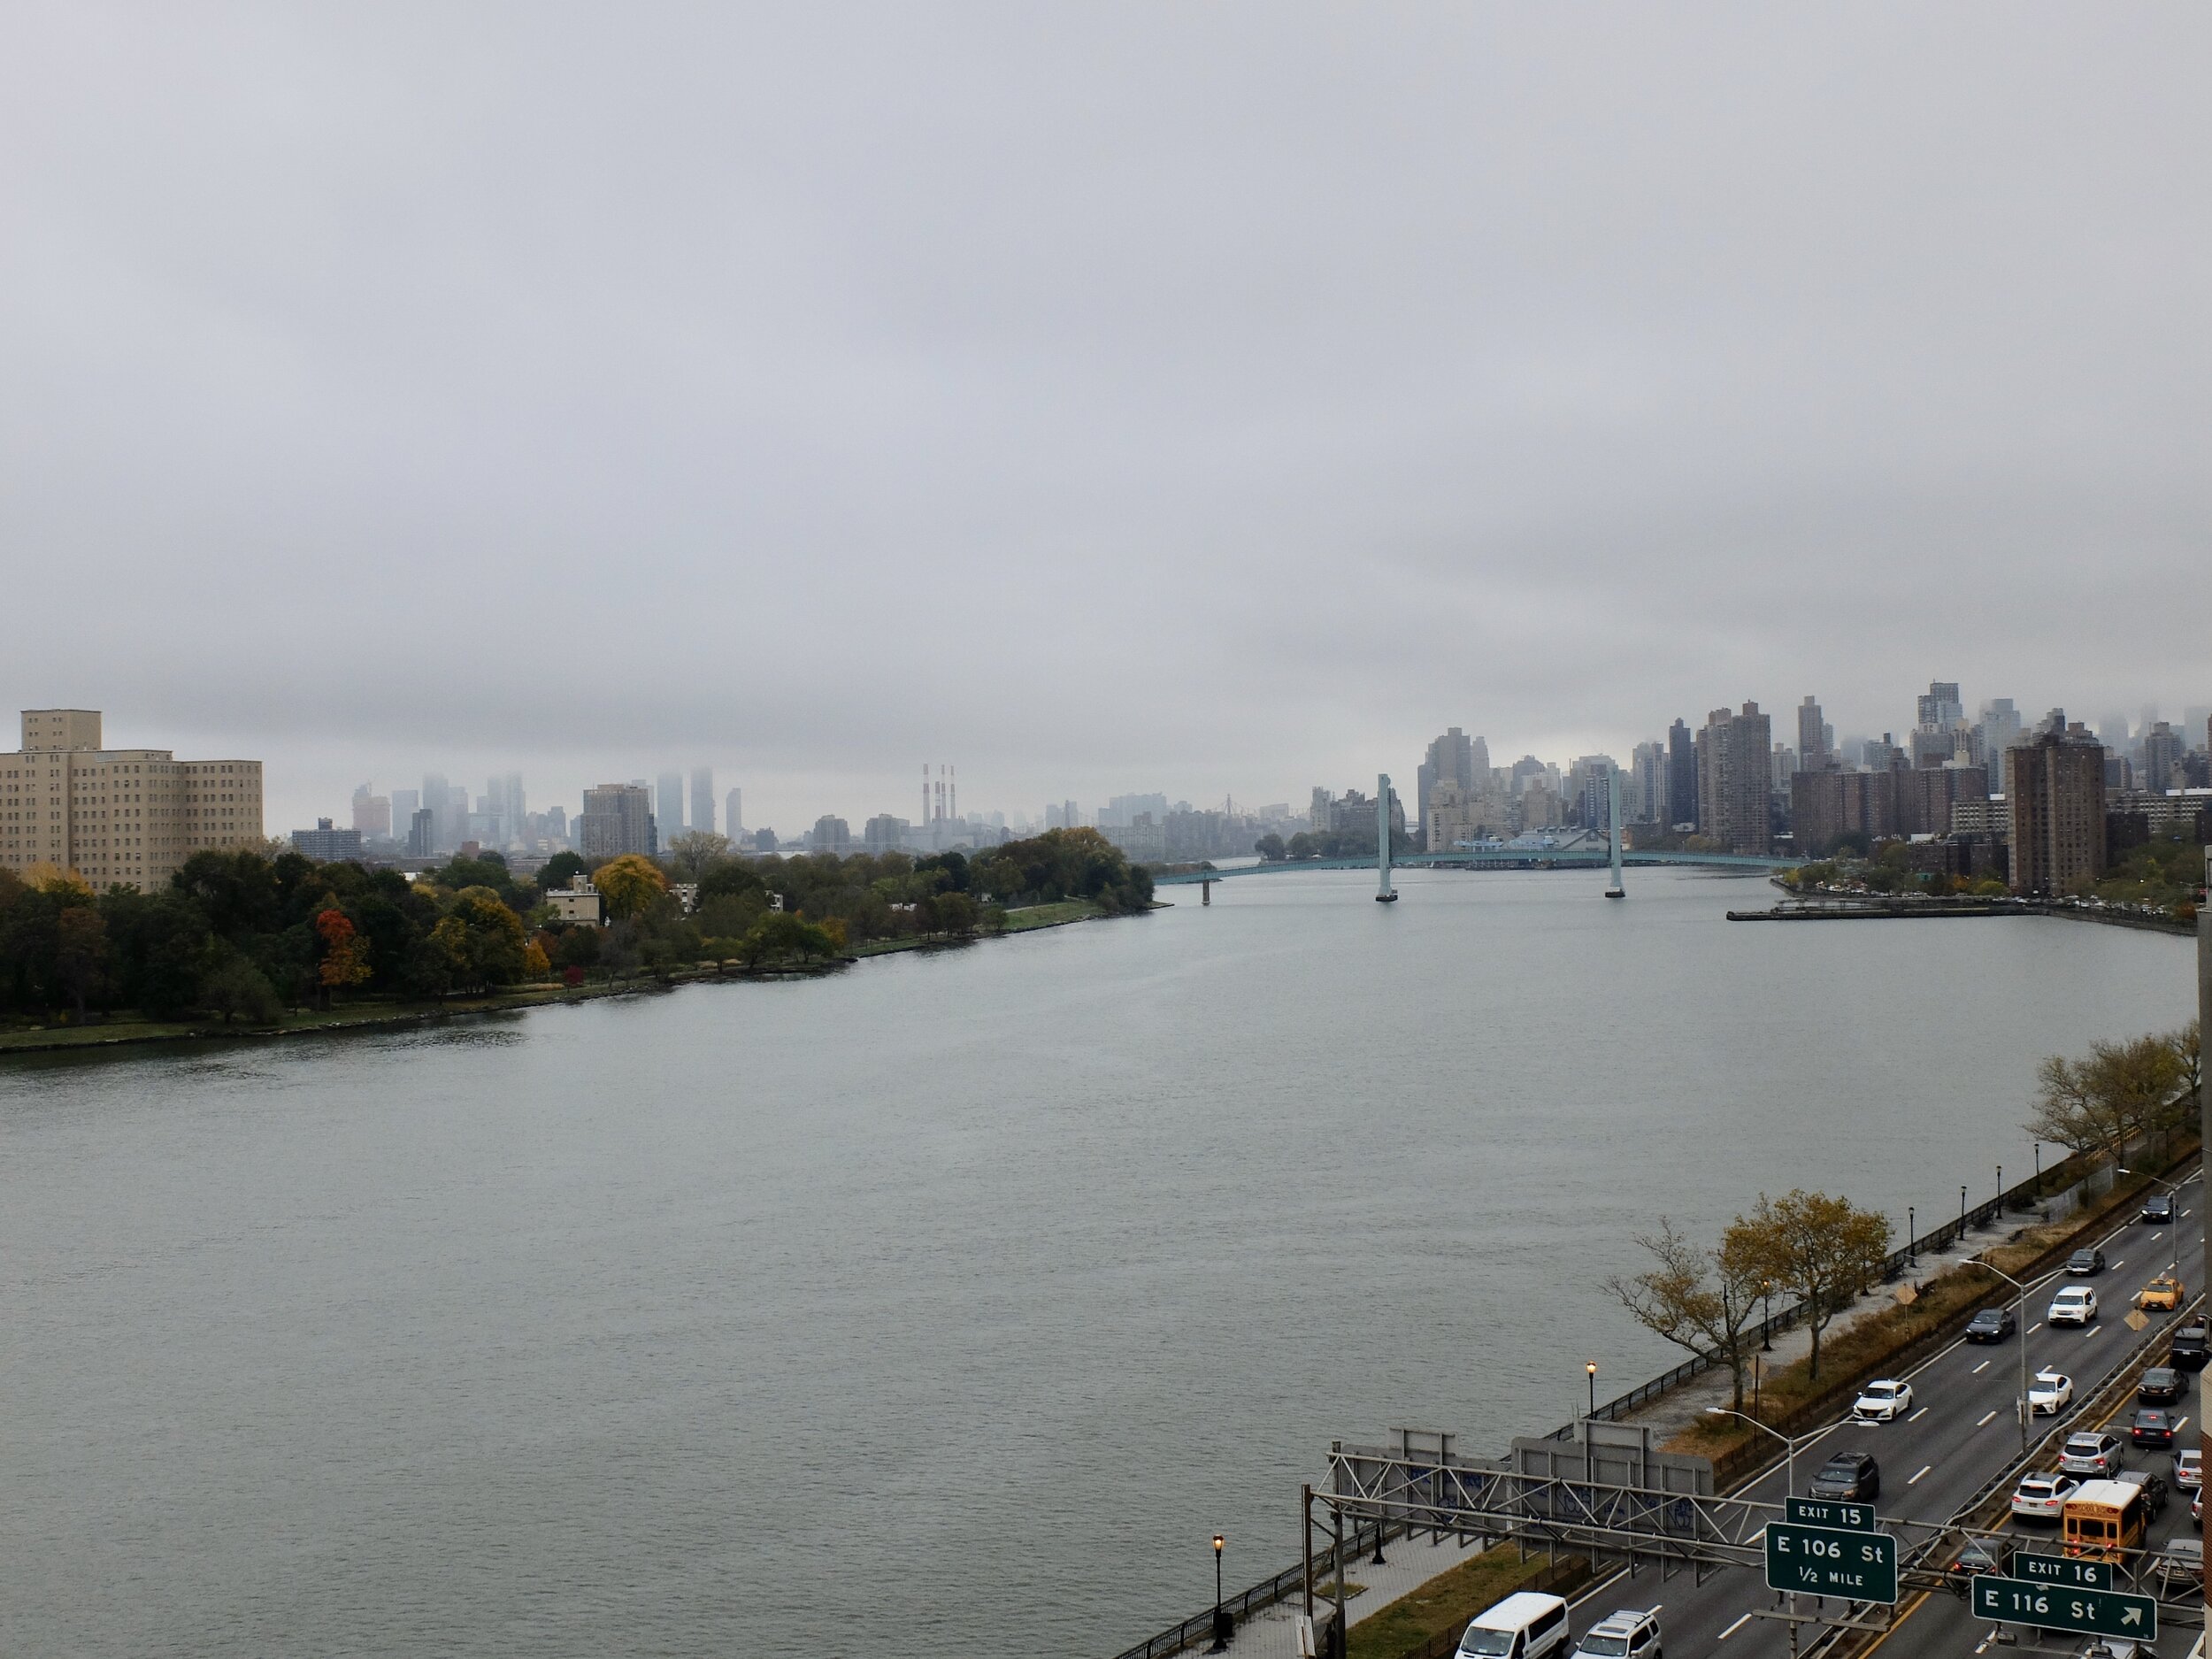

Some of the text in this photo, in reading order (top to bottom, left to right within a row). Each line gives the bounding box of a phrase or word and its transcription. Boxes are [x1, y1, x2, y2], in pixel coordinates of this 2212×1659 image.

[1799, 1505, 1862, 1525] EXIT 15
[1778, 1535, 1884, 1563] E 106 St
[1829, 1571, 1863, 1586] MILE
[2029, 1561, 2097, 1583] EXIT 16
[1985, 1589, 2095, 1620] E 116 St
